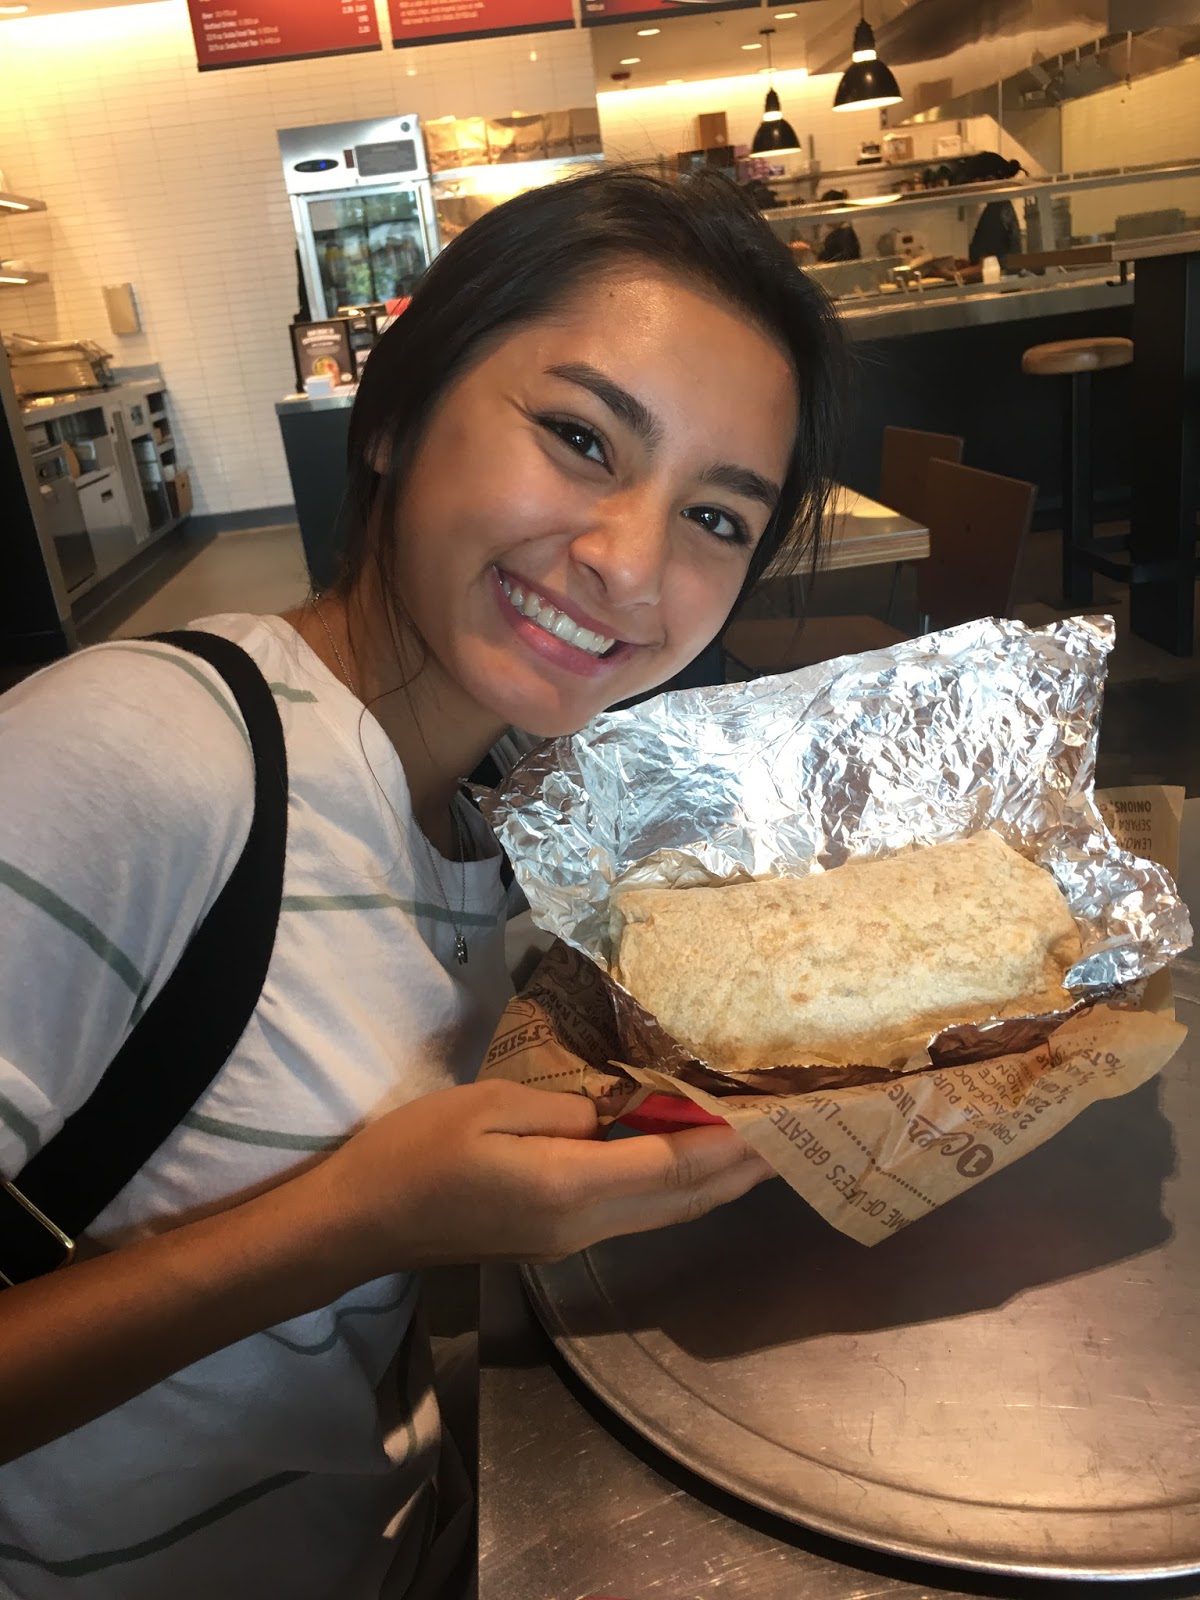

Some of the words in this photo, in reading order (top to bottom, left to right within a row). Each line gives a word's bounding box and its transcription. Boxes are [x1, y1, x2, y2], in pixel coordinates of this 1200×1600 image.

[484, 1024, 553, 1062] LFSIES
[596, 1082, 633, 1098] GHT
[977, 1067, 1010, 1099] JUICE
[805, 1096, 841, 1120] LIK
[760, 1101, 832, 1168] GREATES
[860, 1194, 887, 1217] OF
[880, 1207, 910, 1231] ME
